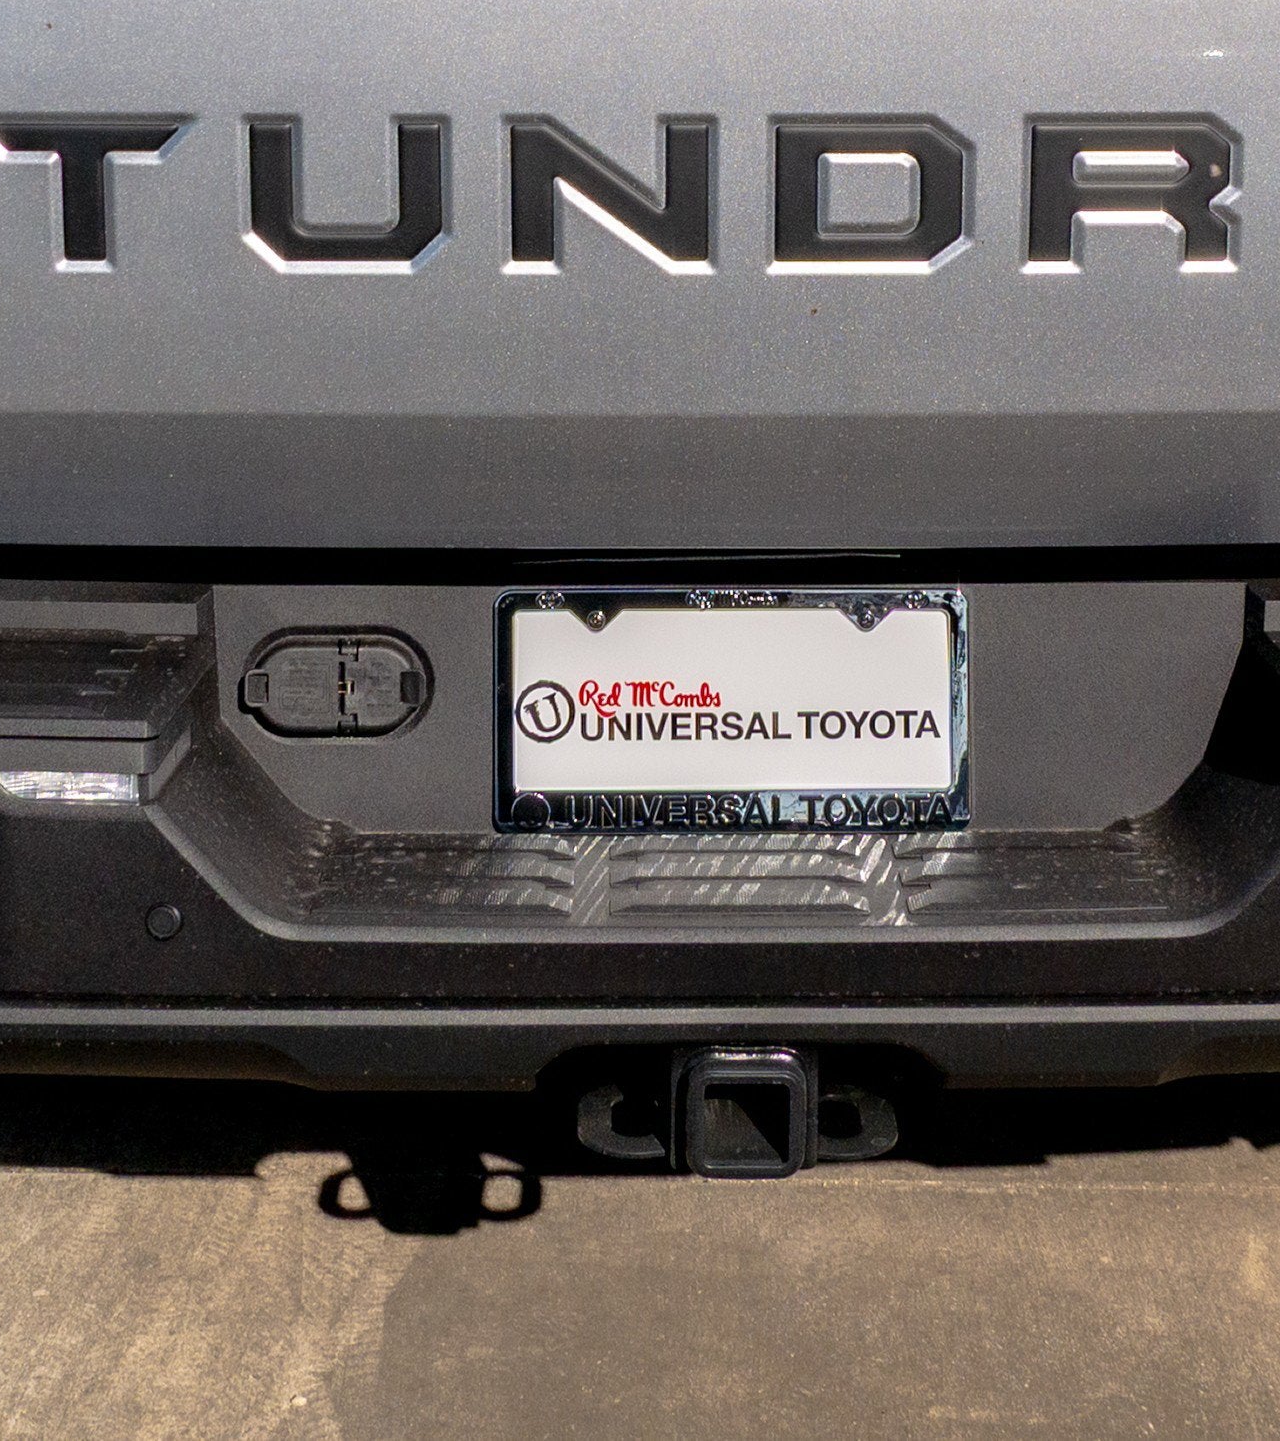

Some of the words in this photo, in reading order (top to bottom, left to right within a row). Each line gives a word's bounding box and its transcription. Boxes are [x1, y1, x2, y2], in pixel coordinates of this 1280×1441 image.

[579, 679, 621, 718] Red
[625, 680, 721, 708] McCombs
[579, 711, 792, 741] UNIVERSAL
[797, 709, 942, 740] TOYOTA
[564, 793, 794, 828] UNIVERSAL
[800, 793, 954, 828] TOYOTA
